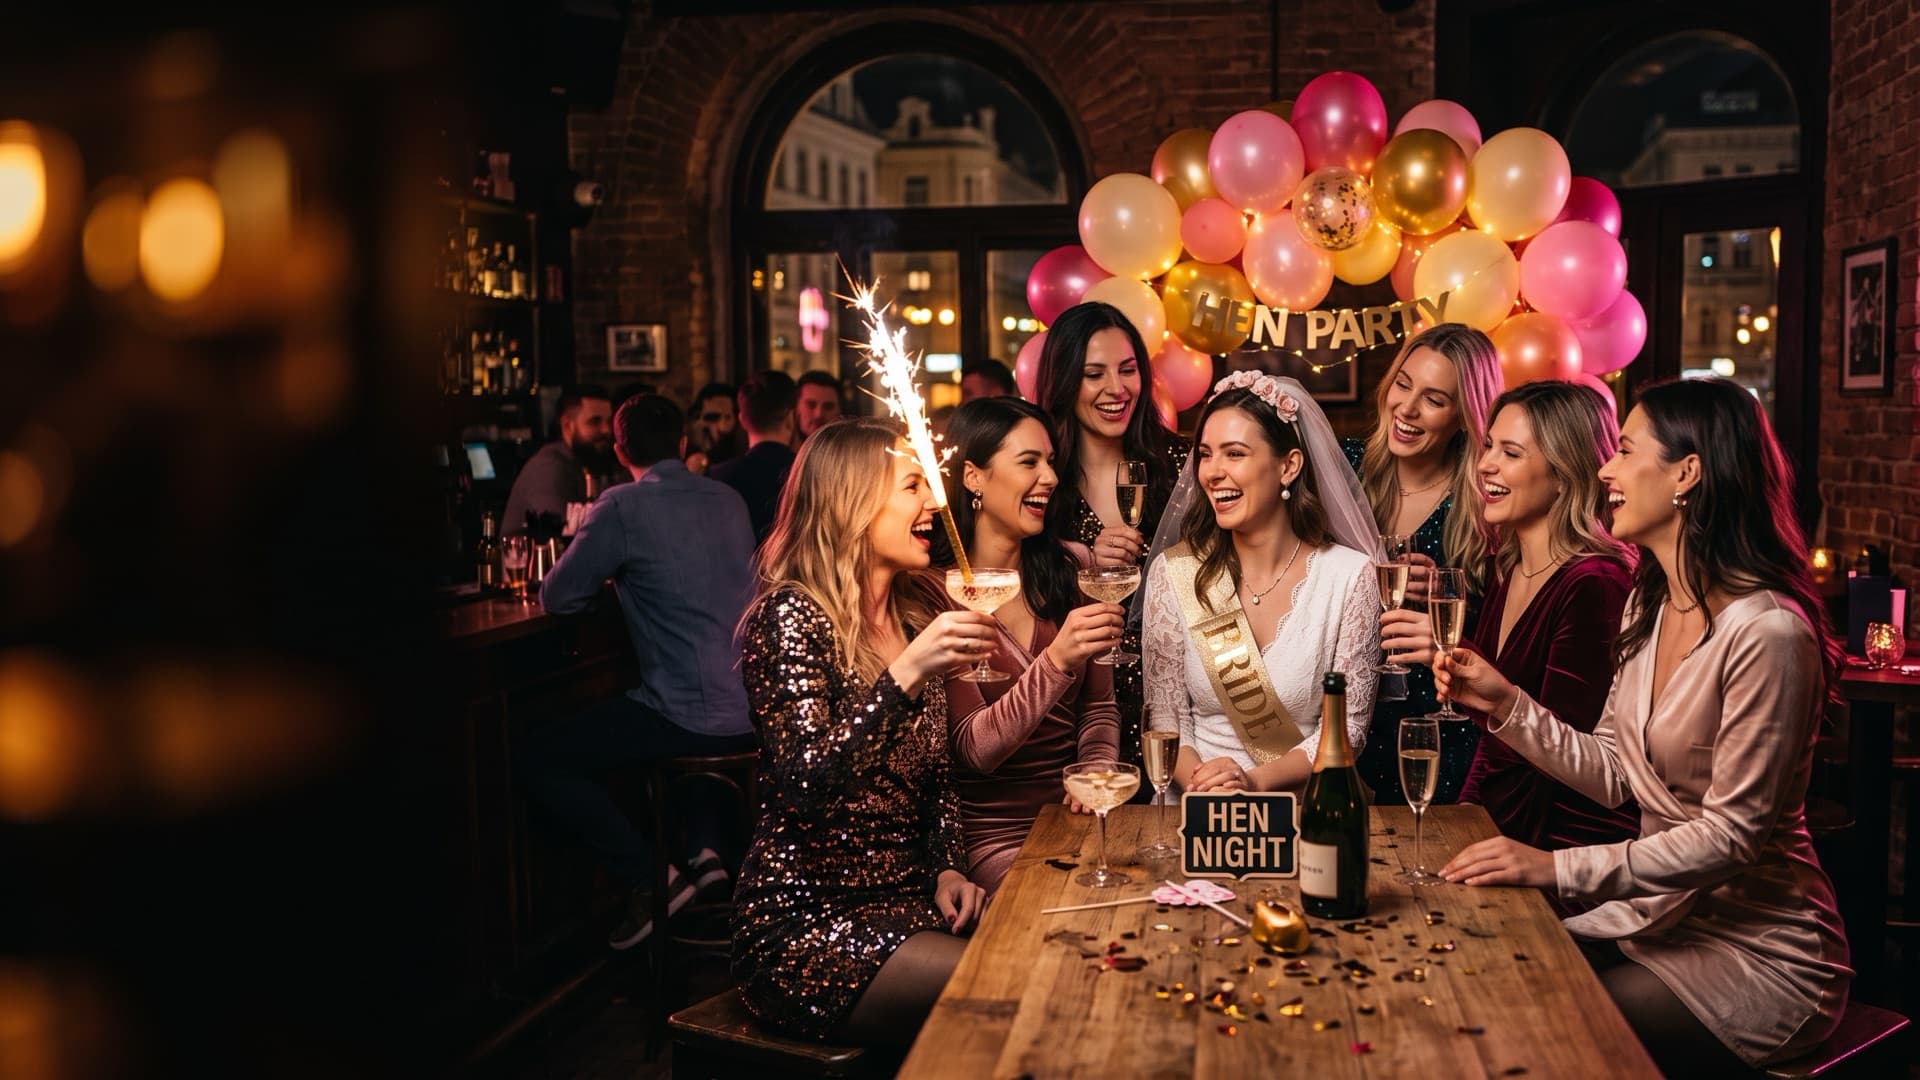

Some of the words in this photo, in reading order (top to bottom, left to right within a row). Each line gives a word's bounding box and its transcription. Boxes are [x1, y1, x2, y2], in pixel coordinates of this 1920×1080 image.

[1191, 291, 1288, 347] HEN
[1306, 290, 1450, 350] PARTY
[1203, 619, 1283, 740] BRIDE
[1208, 802, 1269, 833] HEN
[1192, 836, 1286, 868] NIGHT
